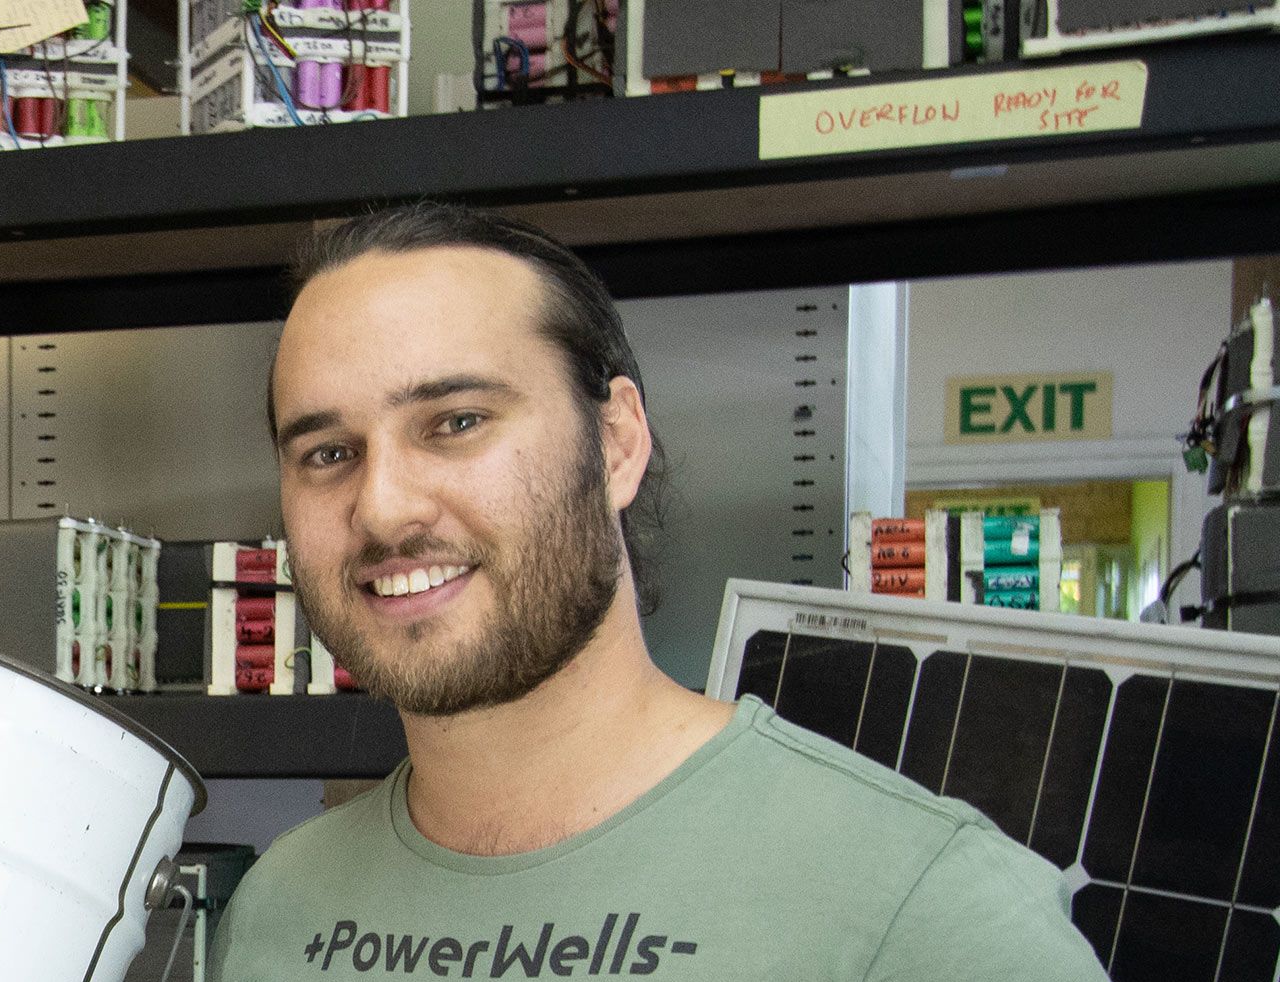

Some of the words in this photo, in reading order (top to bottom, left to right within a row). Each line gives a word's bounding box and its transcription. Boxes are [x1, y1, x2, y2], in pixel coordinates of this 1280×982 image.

[815, 101, 959, 135] OVERFLOW
[993, 87, 1057, 118] READY
[1075, 79, 1121, 102] FOR
[1039, 105, 1098, 131] SITE
[959, 381, 1097, 436] EXIT
